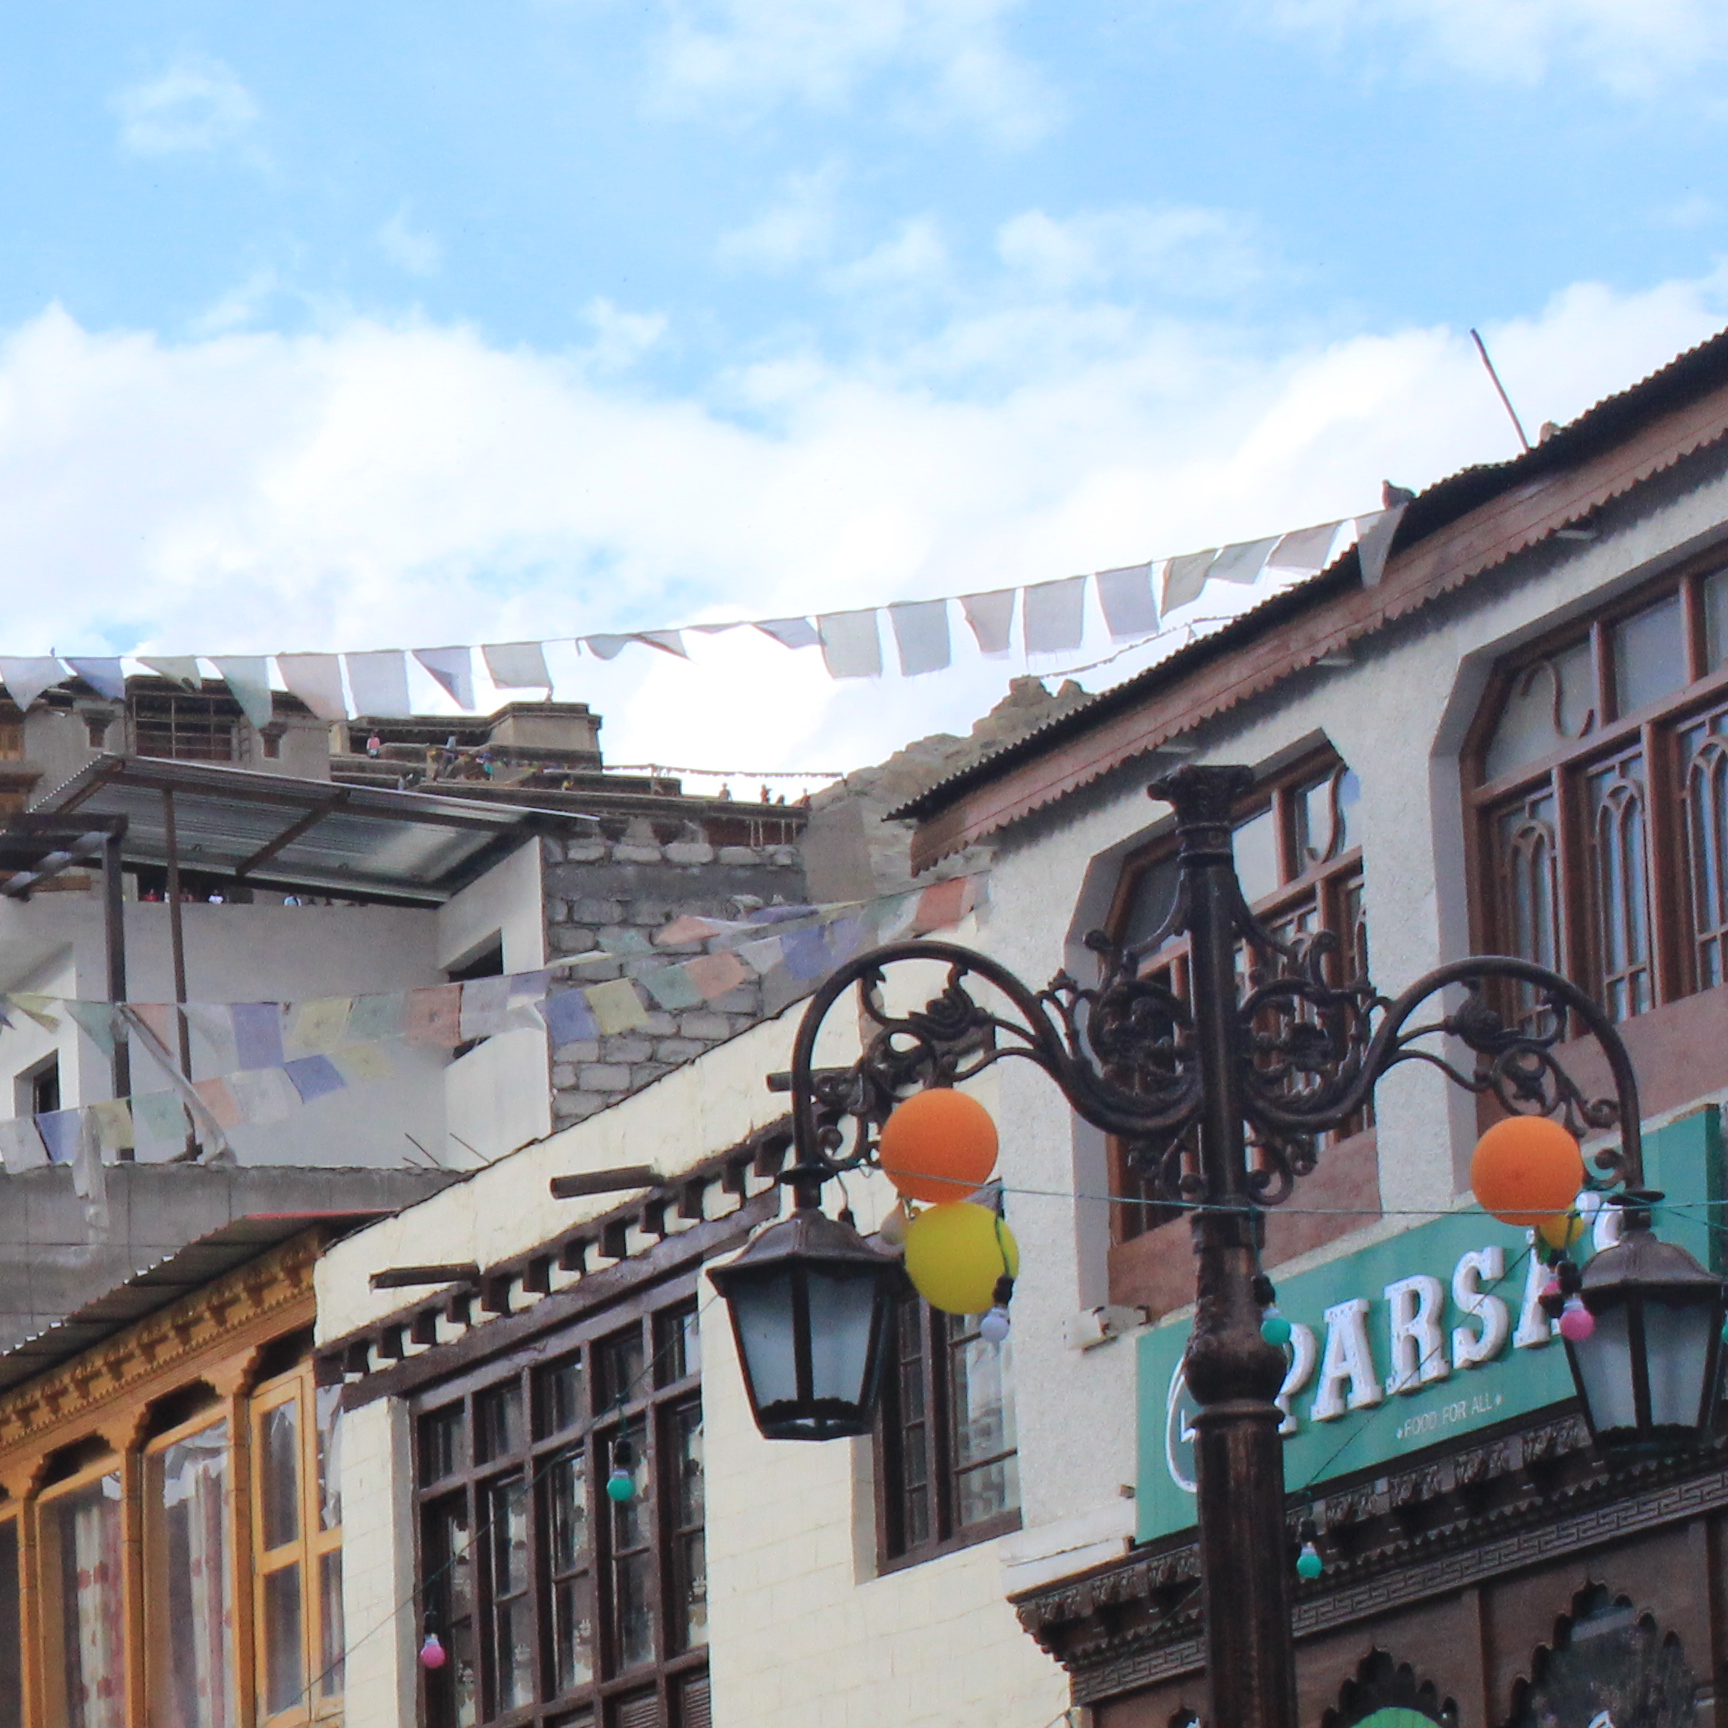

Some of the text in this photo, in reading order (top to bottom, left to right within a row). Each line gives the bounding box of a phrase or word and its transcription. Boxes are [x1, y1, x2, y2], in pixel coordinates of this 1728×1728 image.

[1403, 1396, 1494, 1440] FOOD FOR ALL
